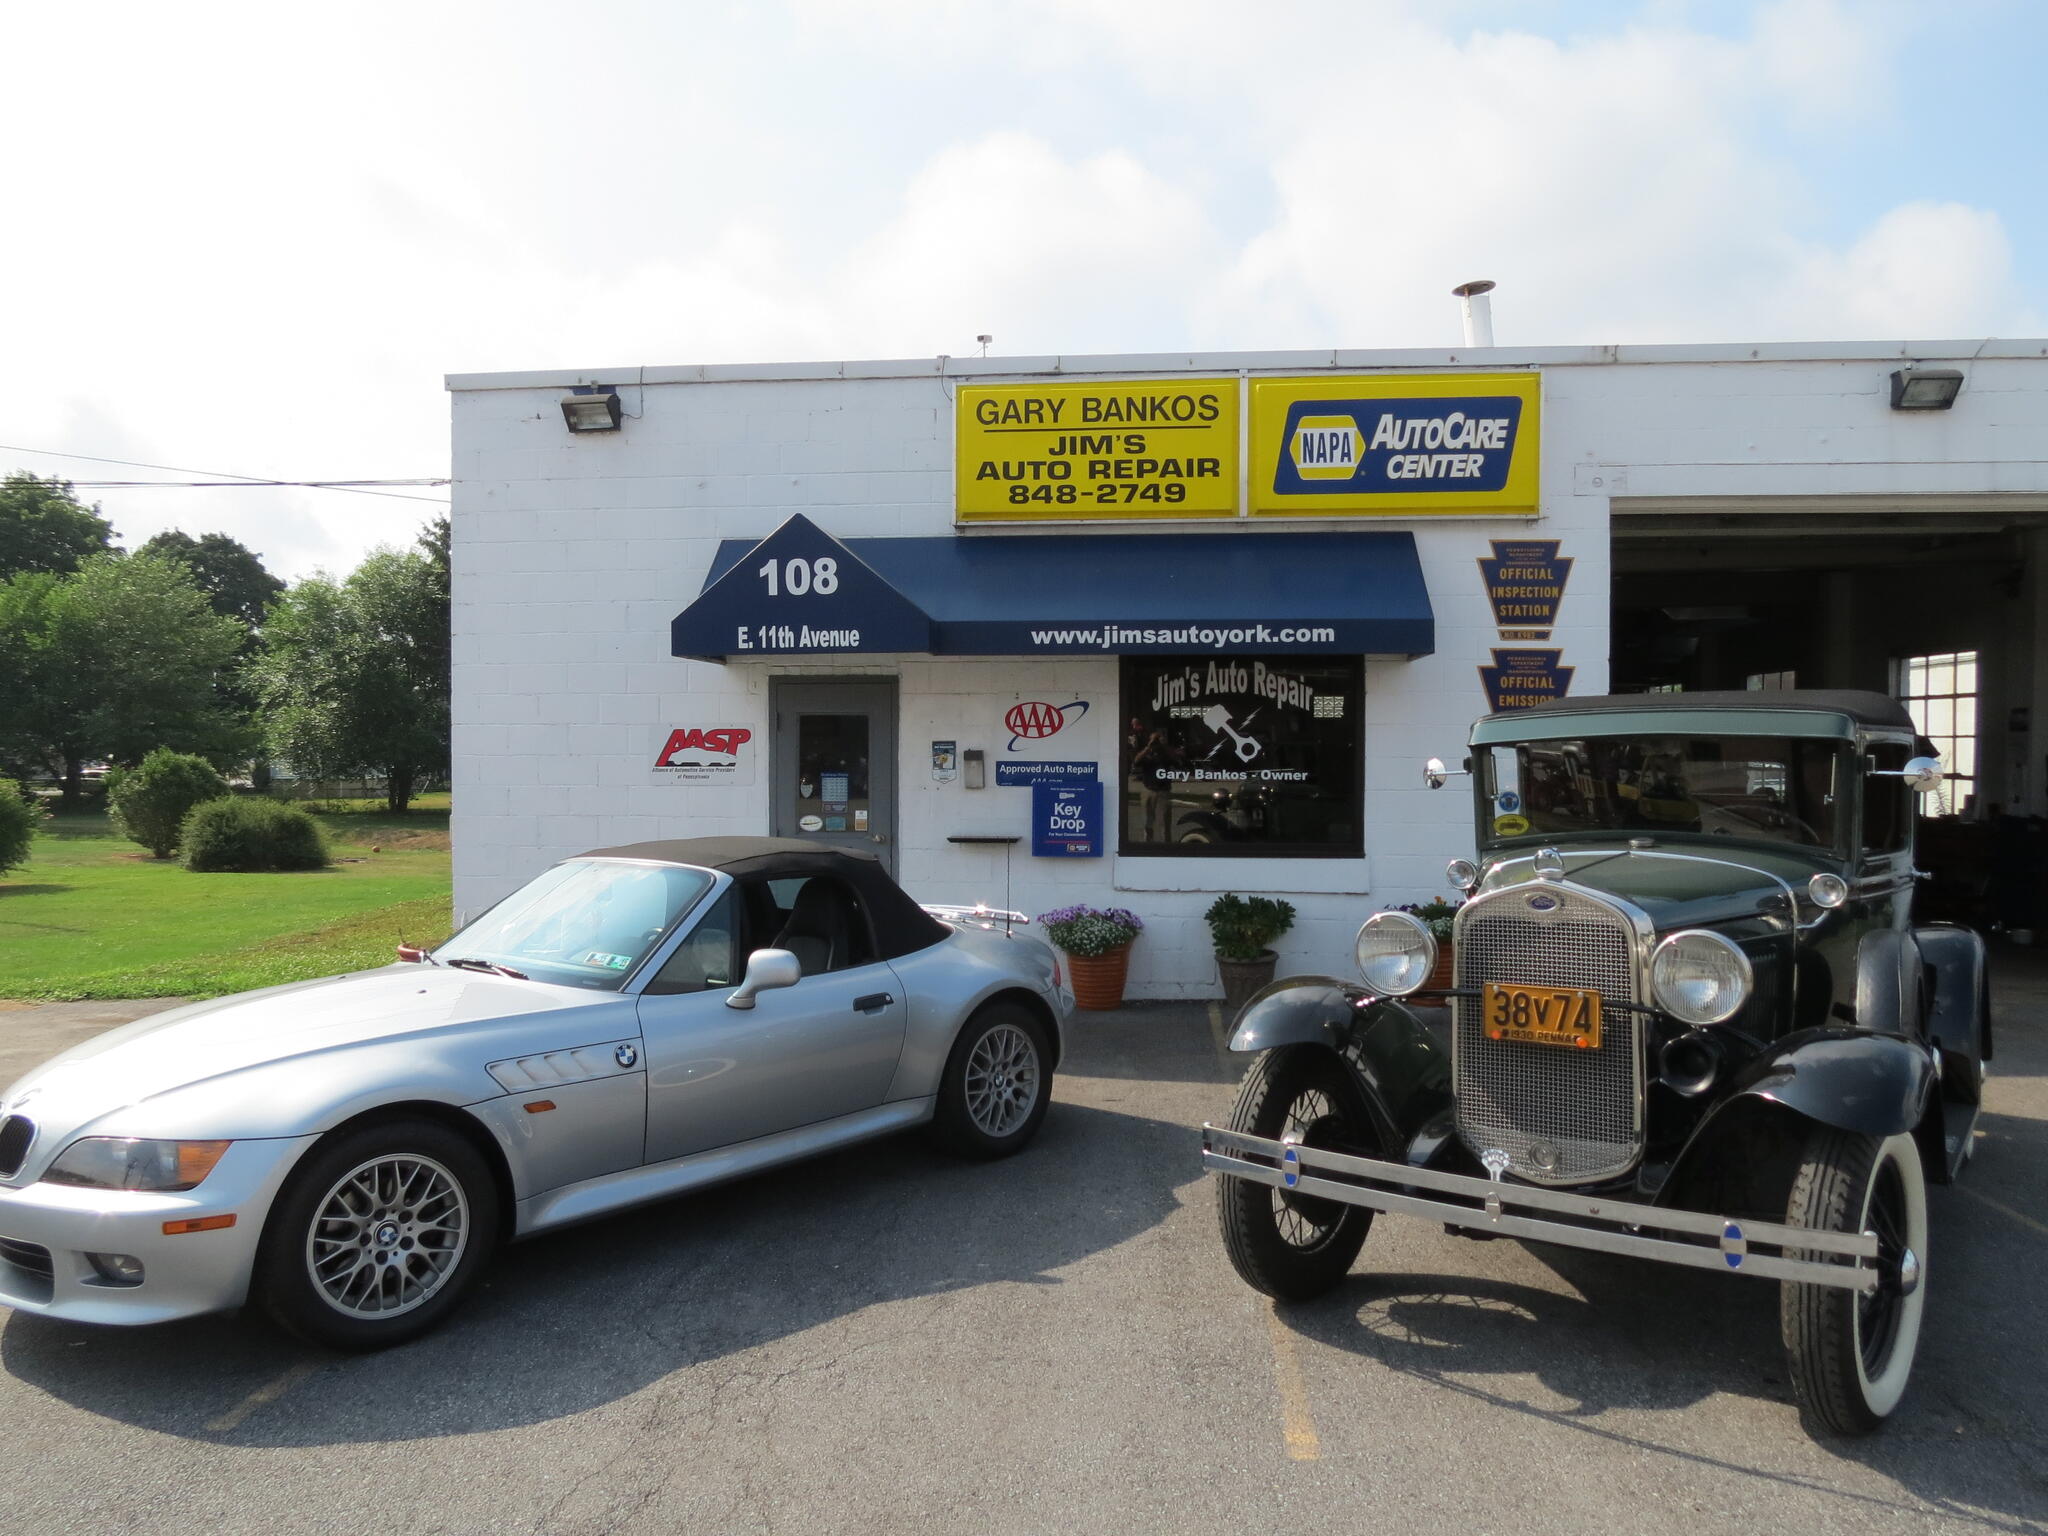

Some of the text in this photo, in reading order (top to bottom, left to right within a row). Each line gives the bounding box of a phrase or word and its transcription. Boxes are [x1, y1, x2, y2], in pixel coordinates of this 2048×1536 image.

[976, 394, 1219, 425] GARY BANKOS
[1048, 434, 1146, 456] JIM'S
[1302, 432, 1352, 463] NAPA
[976, 457, 1220, 480] AUTO REPAIR
[1386, 453, 1484, 480] CENTER
[1008, 483, 1186, 504] 848-2749
[759, 557, 839, 596] 108
[1500, 568, 1554, 580] OFFICIAL
[1492, 586, 1559, 598] INSPECTION
[1500, 605, 1549, 617] STATION
[738, 625, 860, 649] E. 11th Avenue
[1031, 625, 1335, 648] www.jimsautoyork.com
[1152, 660, 1313, 711] Jim's Auto Repair
[1500, 676, 1555, 689] OFFICIAL
[1010, 703, 1058, 738] AAA
[1000, 764, 1094, 775] Approved Auto Repair
[1155, 769, 1190, 782] Gary
[1194, 769, 1247, 780] Bankos
[1260, 770, 1308, 780] Owner
[1054, 802, 1082, 819] Key
[1050, 816, 1085, 832] Drop
[1493, 989, 1592, 1034] 38V74
